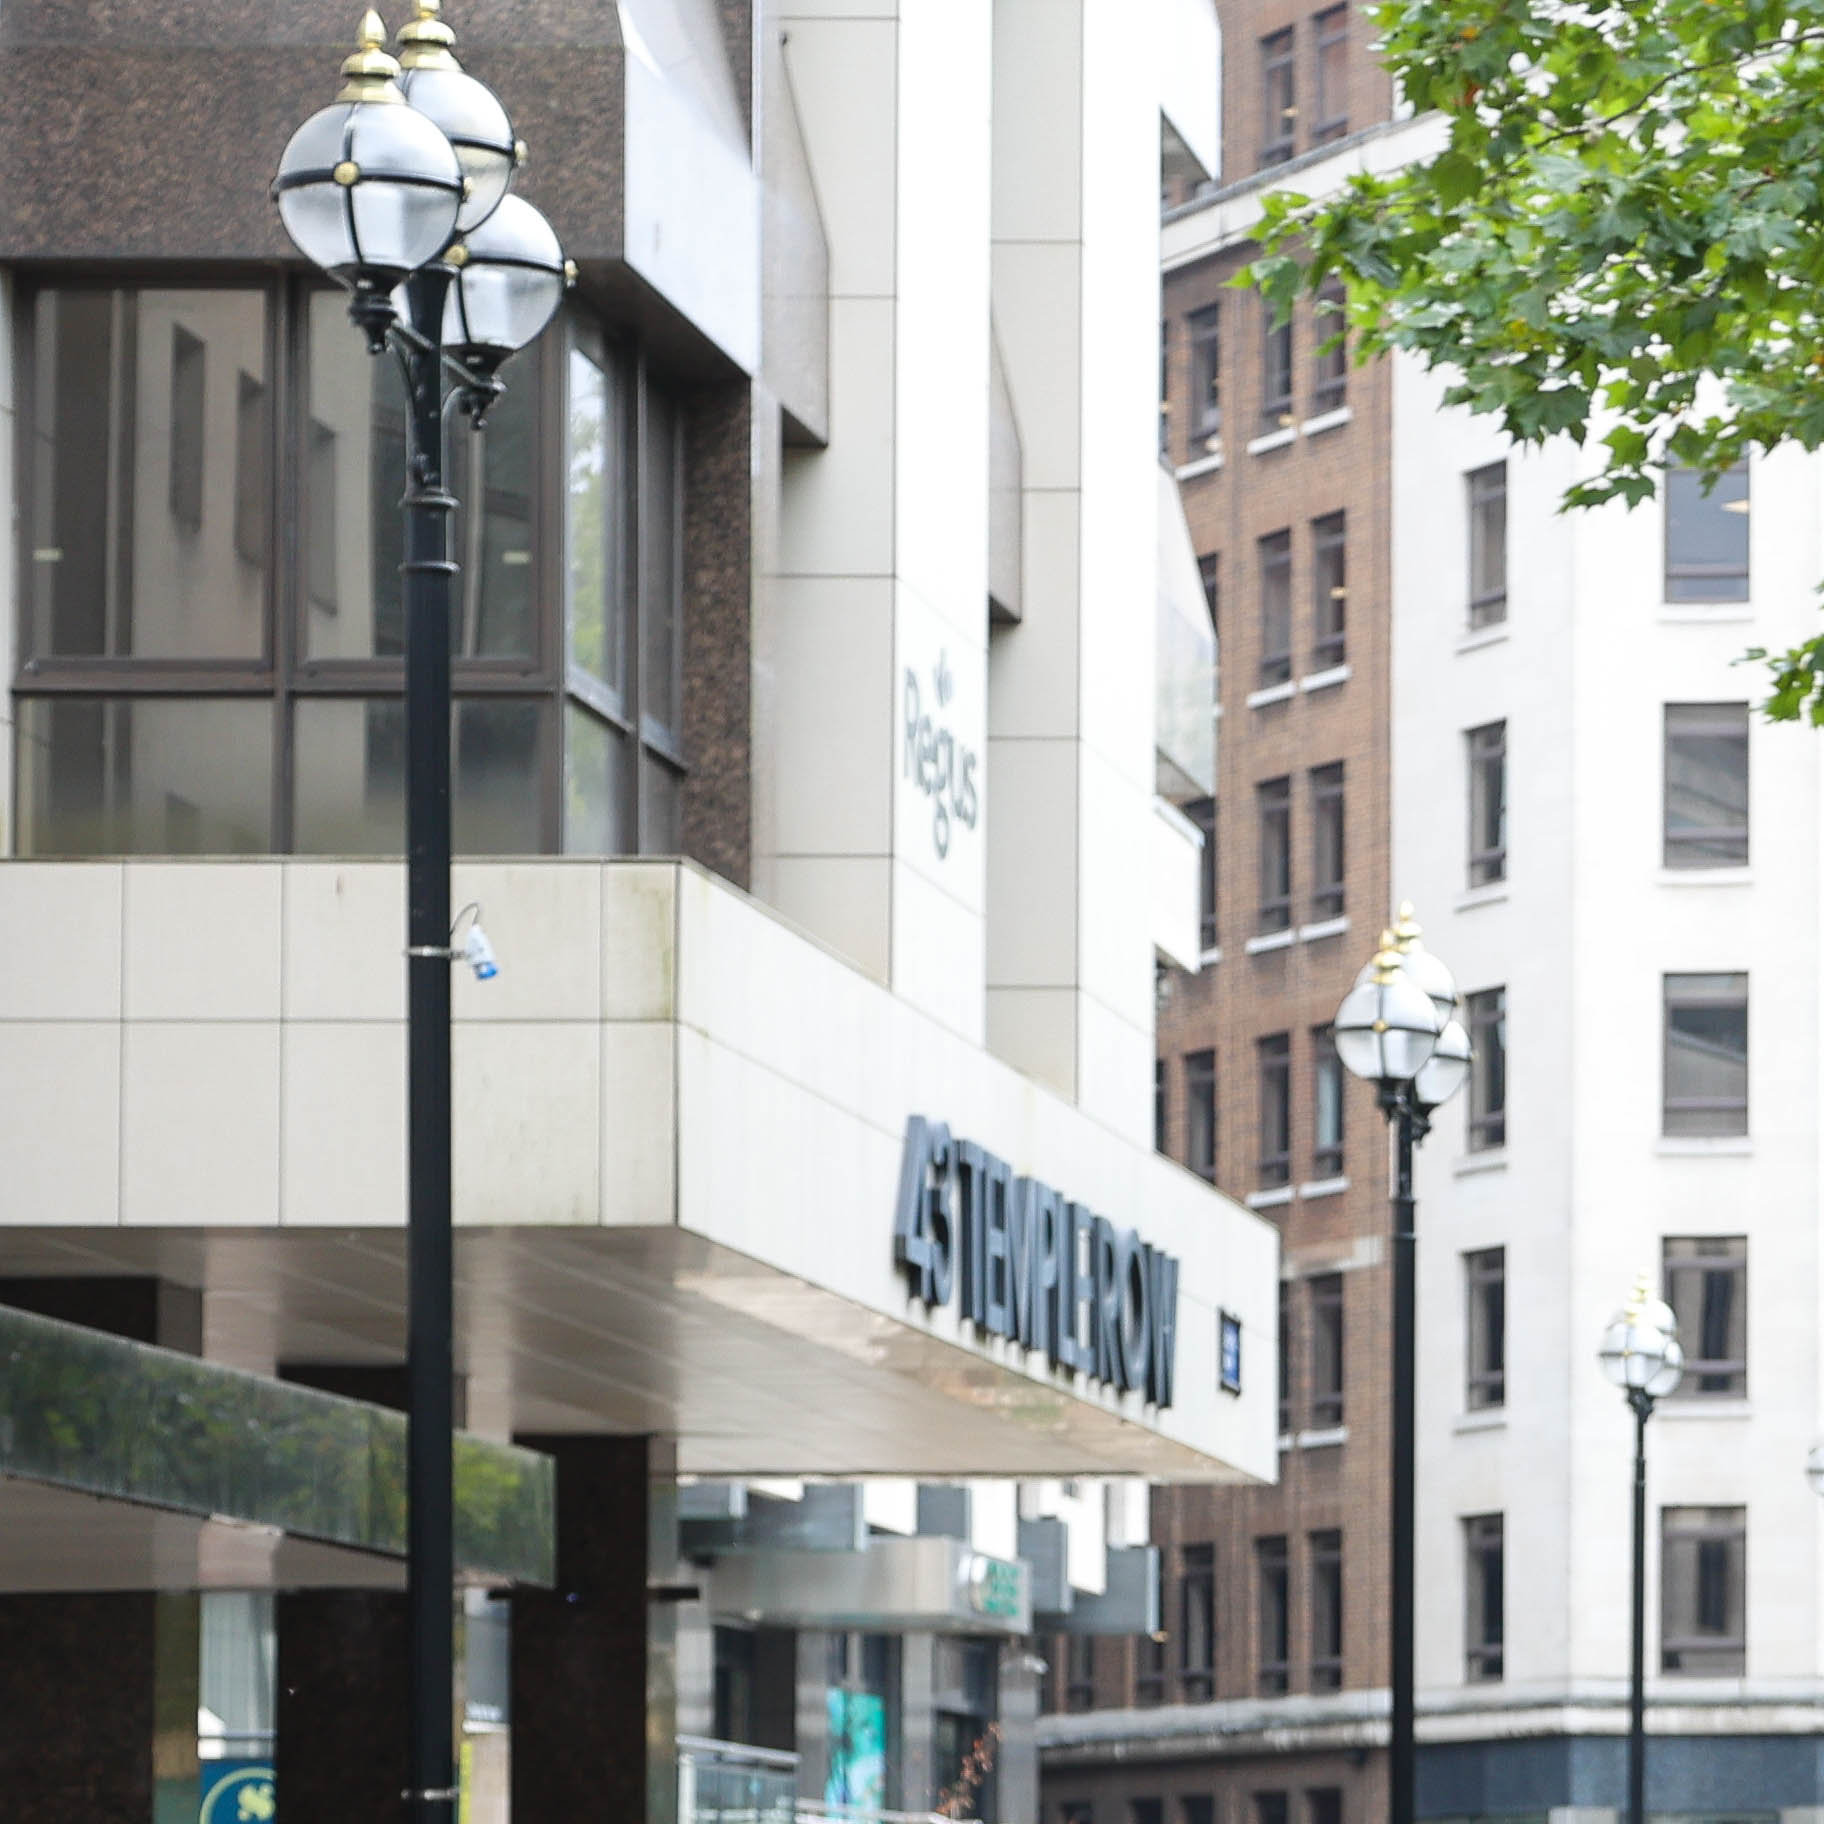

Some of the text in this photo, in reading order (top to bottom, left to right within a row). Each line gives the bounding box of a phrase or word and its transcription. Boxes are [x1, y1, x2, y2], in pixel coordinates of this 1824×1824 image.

[904, 665, 977, 861] Regus
[952, 1137, 1097, 1382] TEMPLE
[1091, 1214, 1180, 1410] ROW
